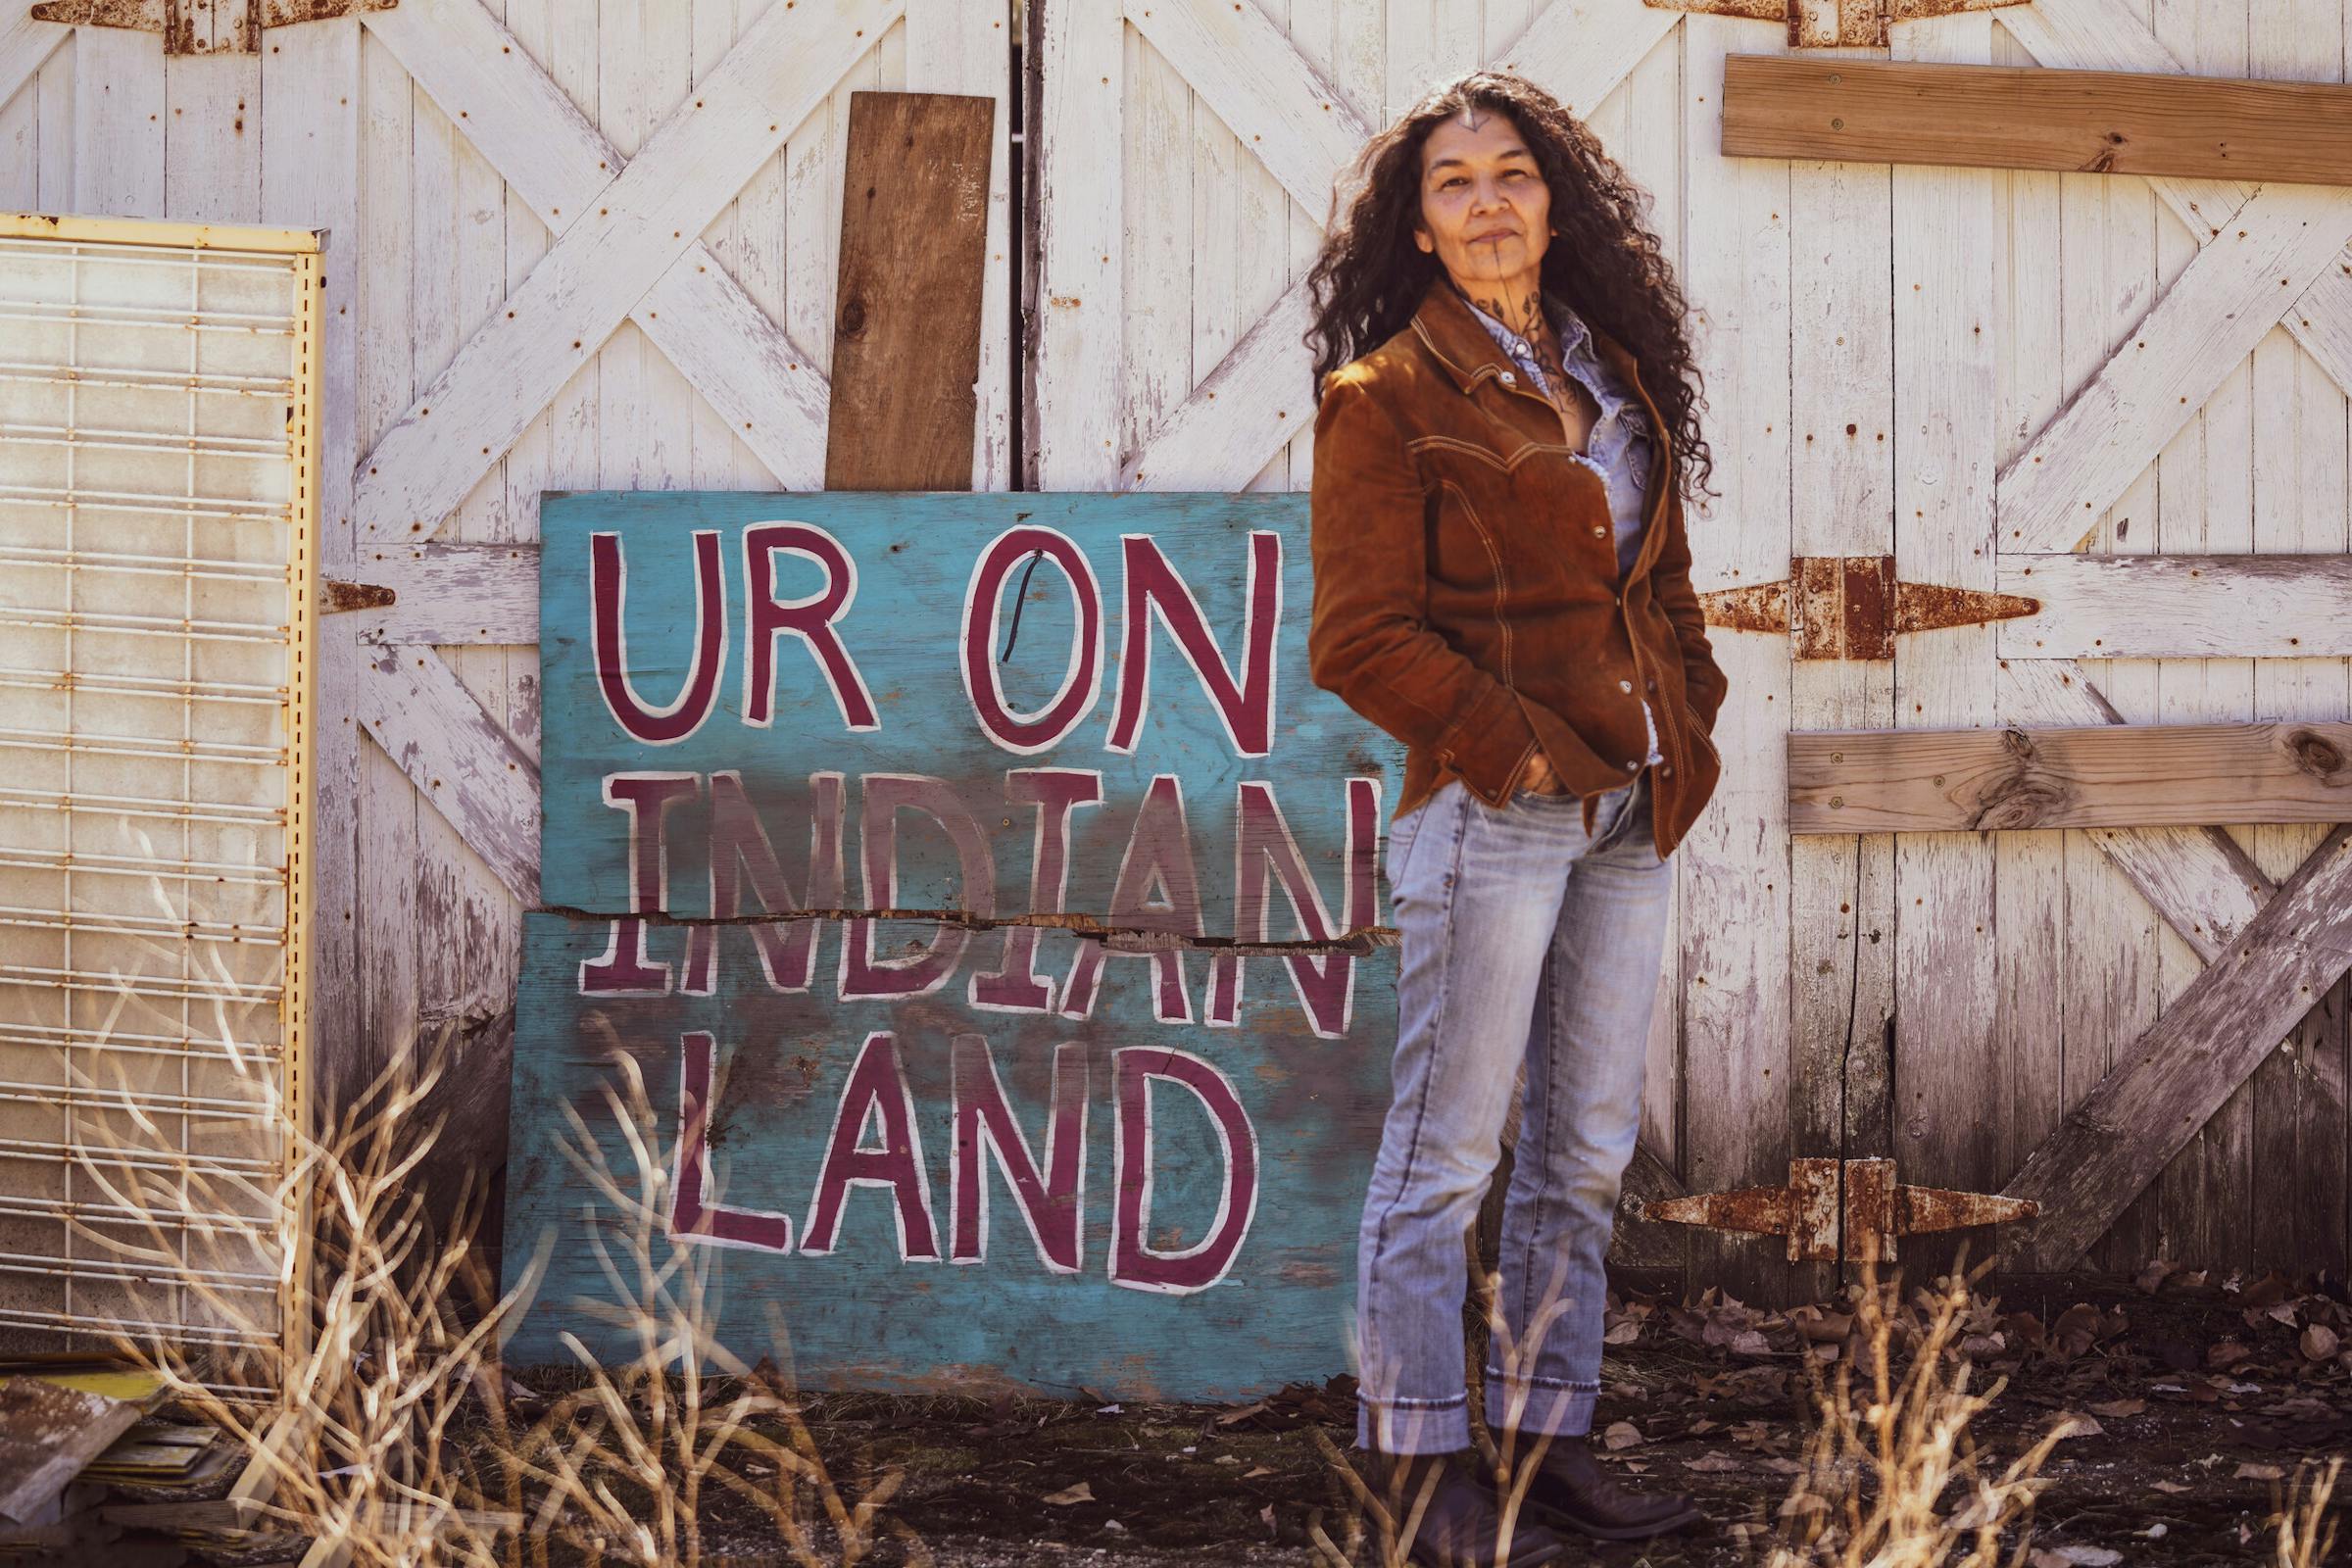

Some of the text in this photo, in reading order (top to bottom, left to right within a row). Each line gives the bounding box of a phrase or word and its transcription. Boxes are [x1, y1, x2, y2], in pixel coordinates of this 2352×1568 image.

[590, 520, 1283, 758] UR ON
[578, 767, 1382, 1039] INDIAN
[664, 1030, 1259, 1296] LAND
